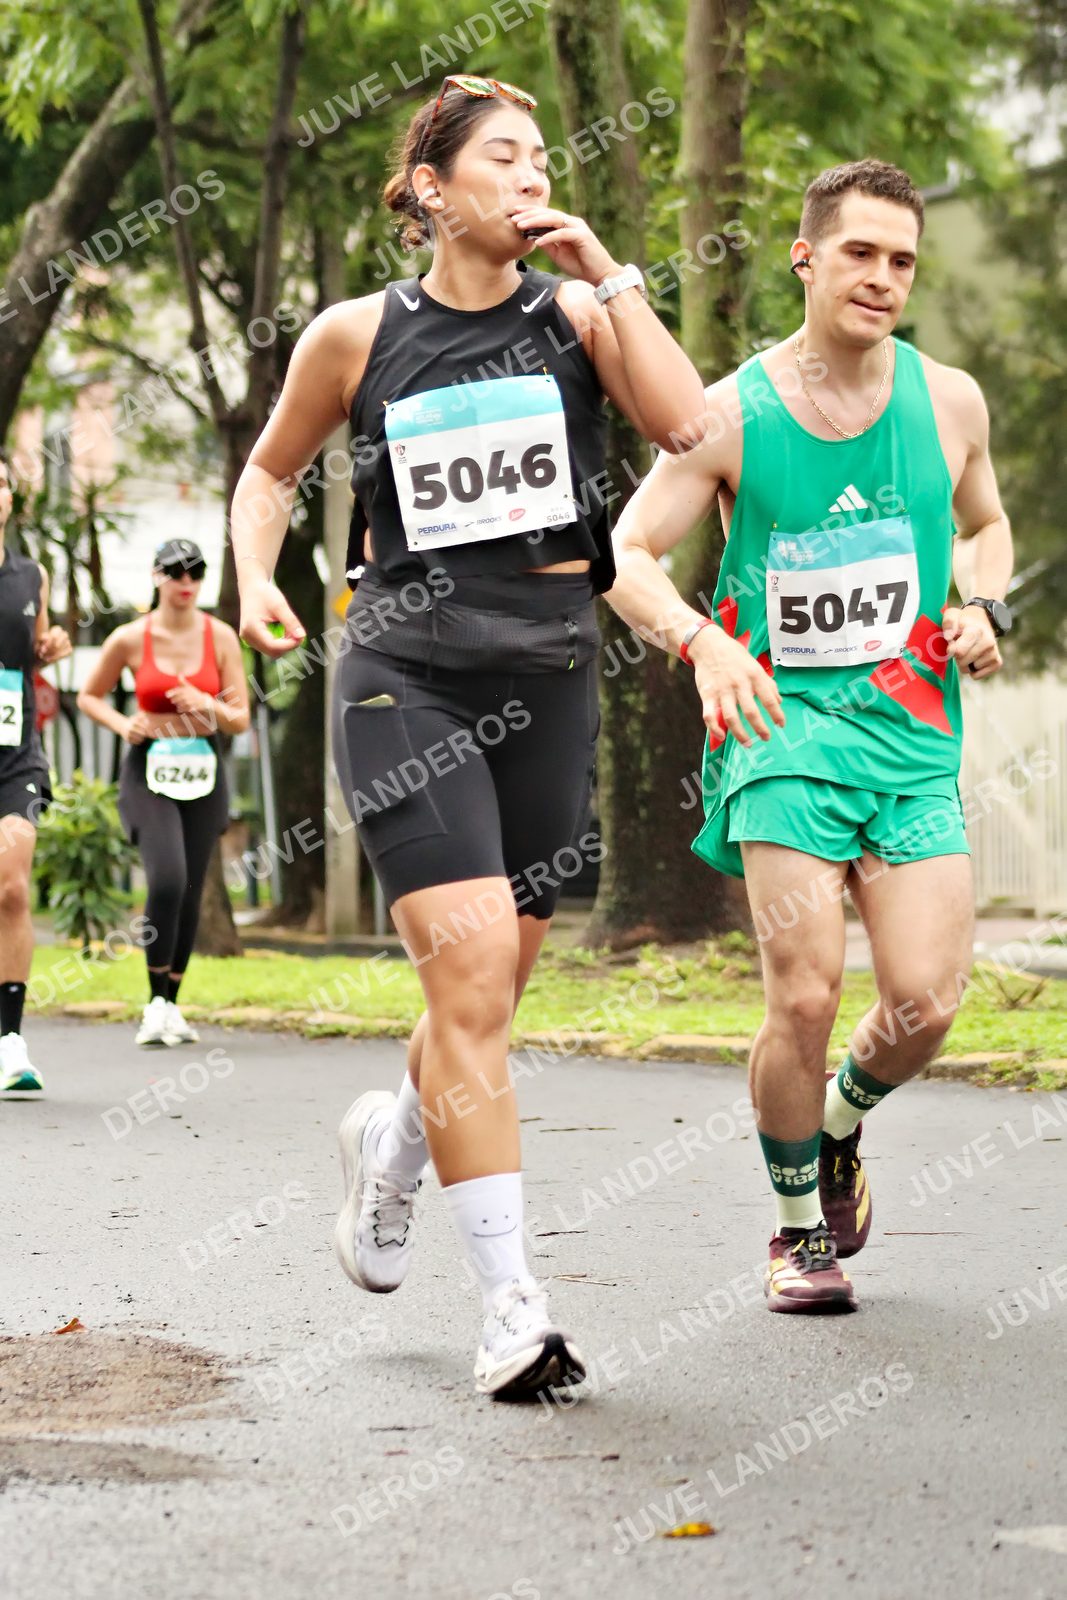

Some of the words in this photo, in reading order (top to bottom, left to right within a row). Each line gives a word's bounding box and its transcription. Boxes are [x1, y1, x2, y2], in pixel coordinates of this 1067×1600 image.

[409, 443, 557, 510] 5046
[546, 512, 570, 523] 5046
[418, 523, 457, 535] PERDURA
[779, 581, 908, 634] 5047
[782, 647, 816, 655] PERDURA
[154, 767, 208, 783] 6244
